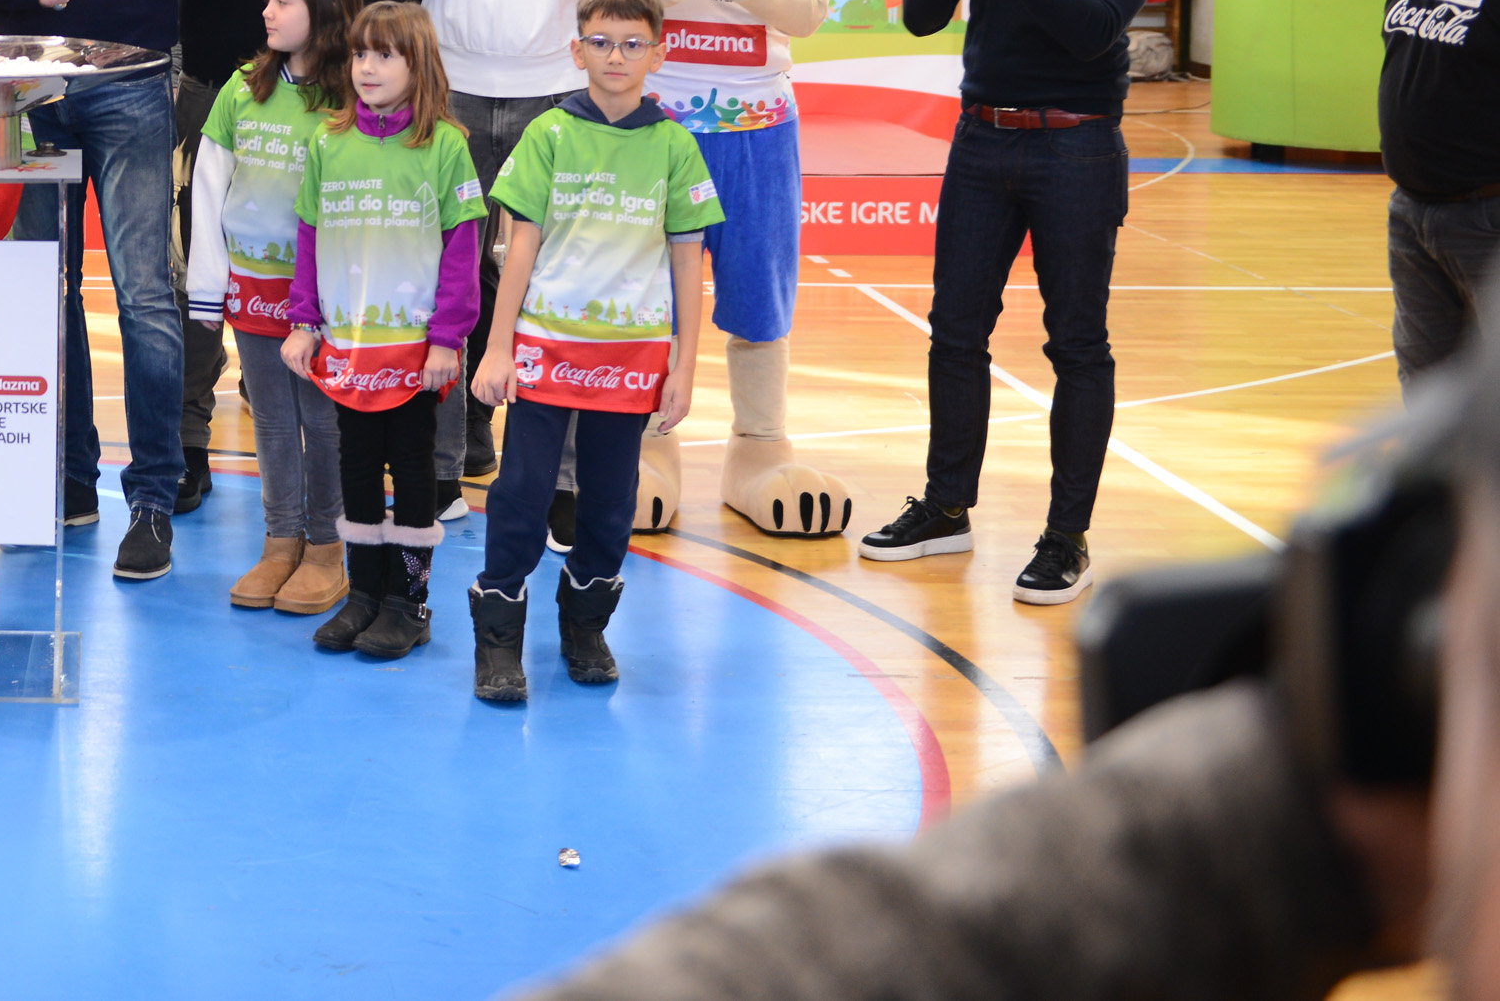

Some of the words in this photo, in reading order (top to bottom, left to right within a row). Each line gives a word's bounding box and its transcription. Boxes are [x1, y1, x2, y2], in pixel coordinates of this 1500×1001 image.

[665, 28, 754, 53] plazma
[236, 120, 258, 130] ZERO
[259, 122, 293, 136] WASTE
[264, 137, 290, 156] dio
[292, 141, 308, 162] ig
[287, 161, 306, 174] pla
[554, 172, 582, 184] ZERO
[584, 172, 617, 185] WASTE
[321, 181, 346, 193] ZERO
[348, 179, 383, 190] WASTE
[321, 195, 355, 214] budi
[358, 194, 383, 212] dio
[387, 194, 421, 217] igre
[588, 186, 616, 207] dio
[620, 190, 657, 214] igre
[615, 212, 655, 227] planet
[851, 201, 911, 225] IGRE
[550, 361, 625, 389] Coca-Cola
